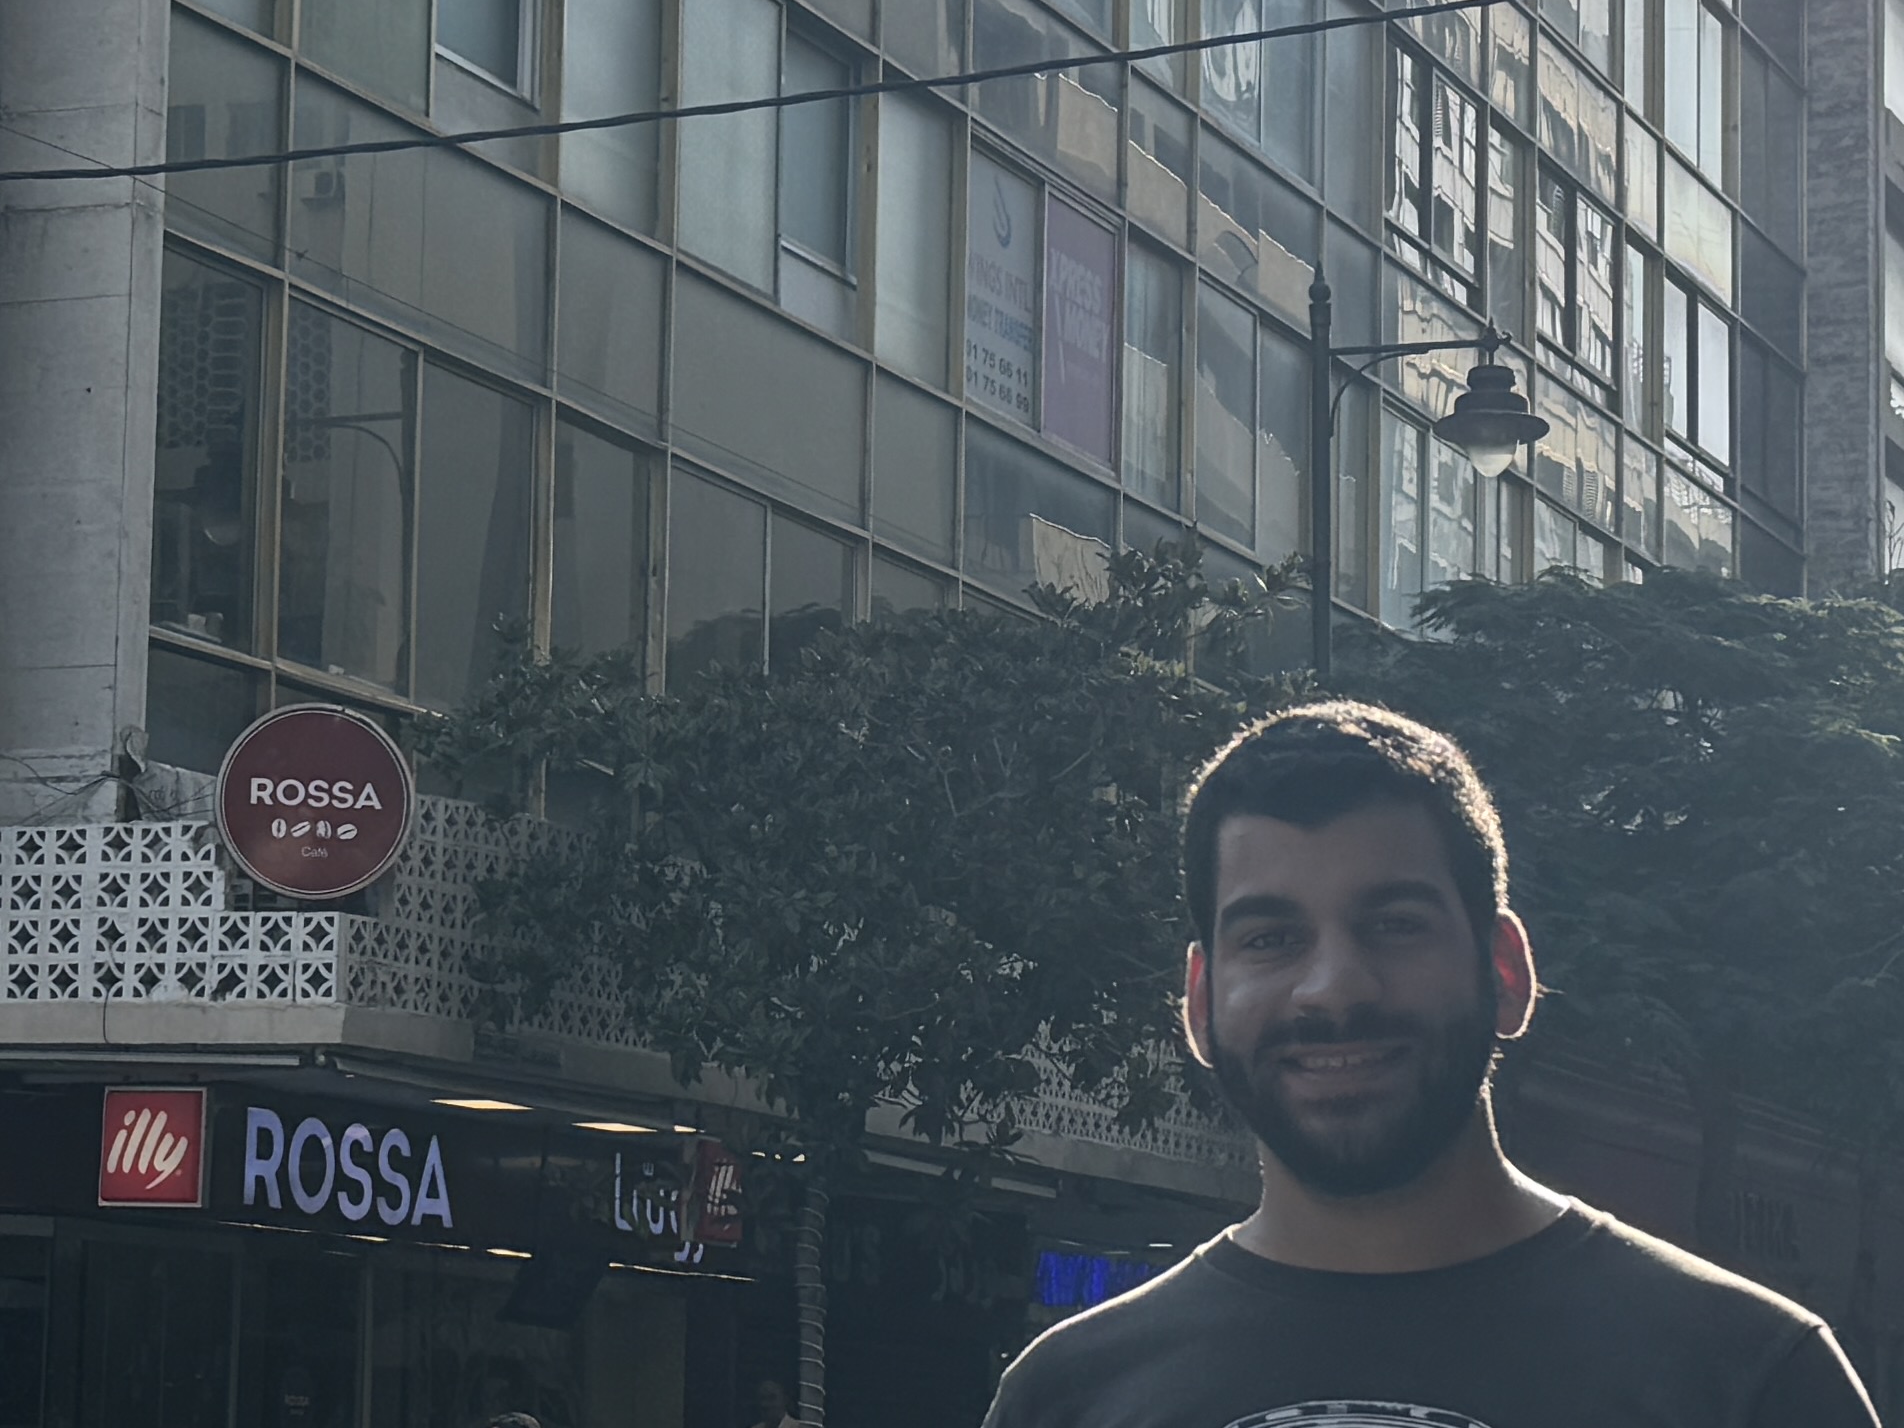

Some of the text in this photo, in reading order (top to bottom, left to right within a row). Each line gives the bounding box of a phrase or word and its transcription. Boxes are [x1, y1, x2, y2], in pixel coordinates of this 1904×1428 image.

[250, 777, 382, 811] ROSSA
[106, 1108, 184, 1190] illy
[242, 1106, 454, 1230] ROSSA
